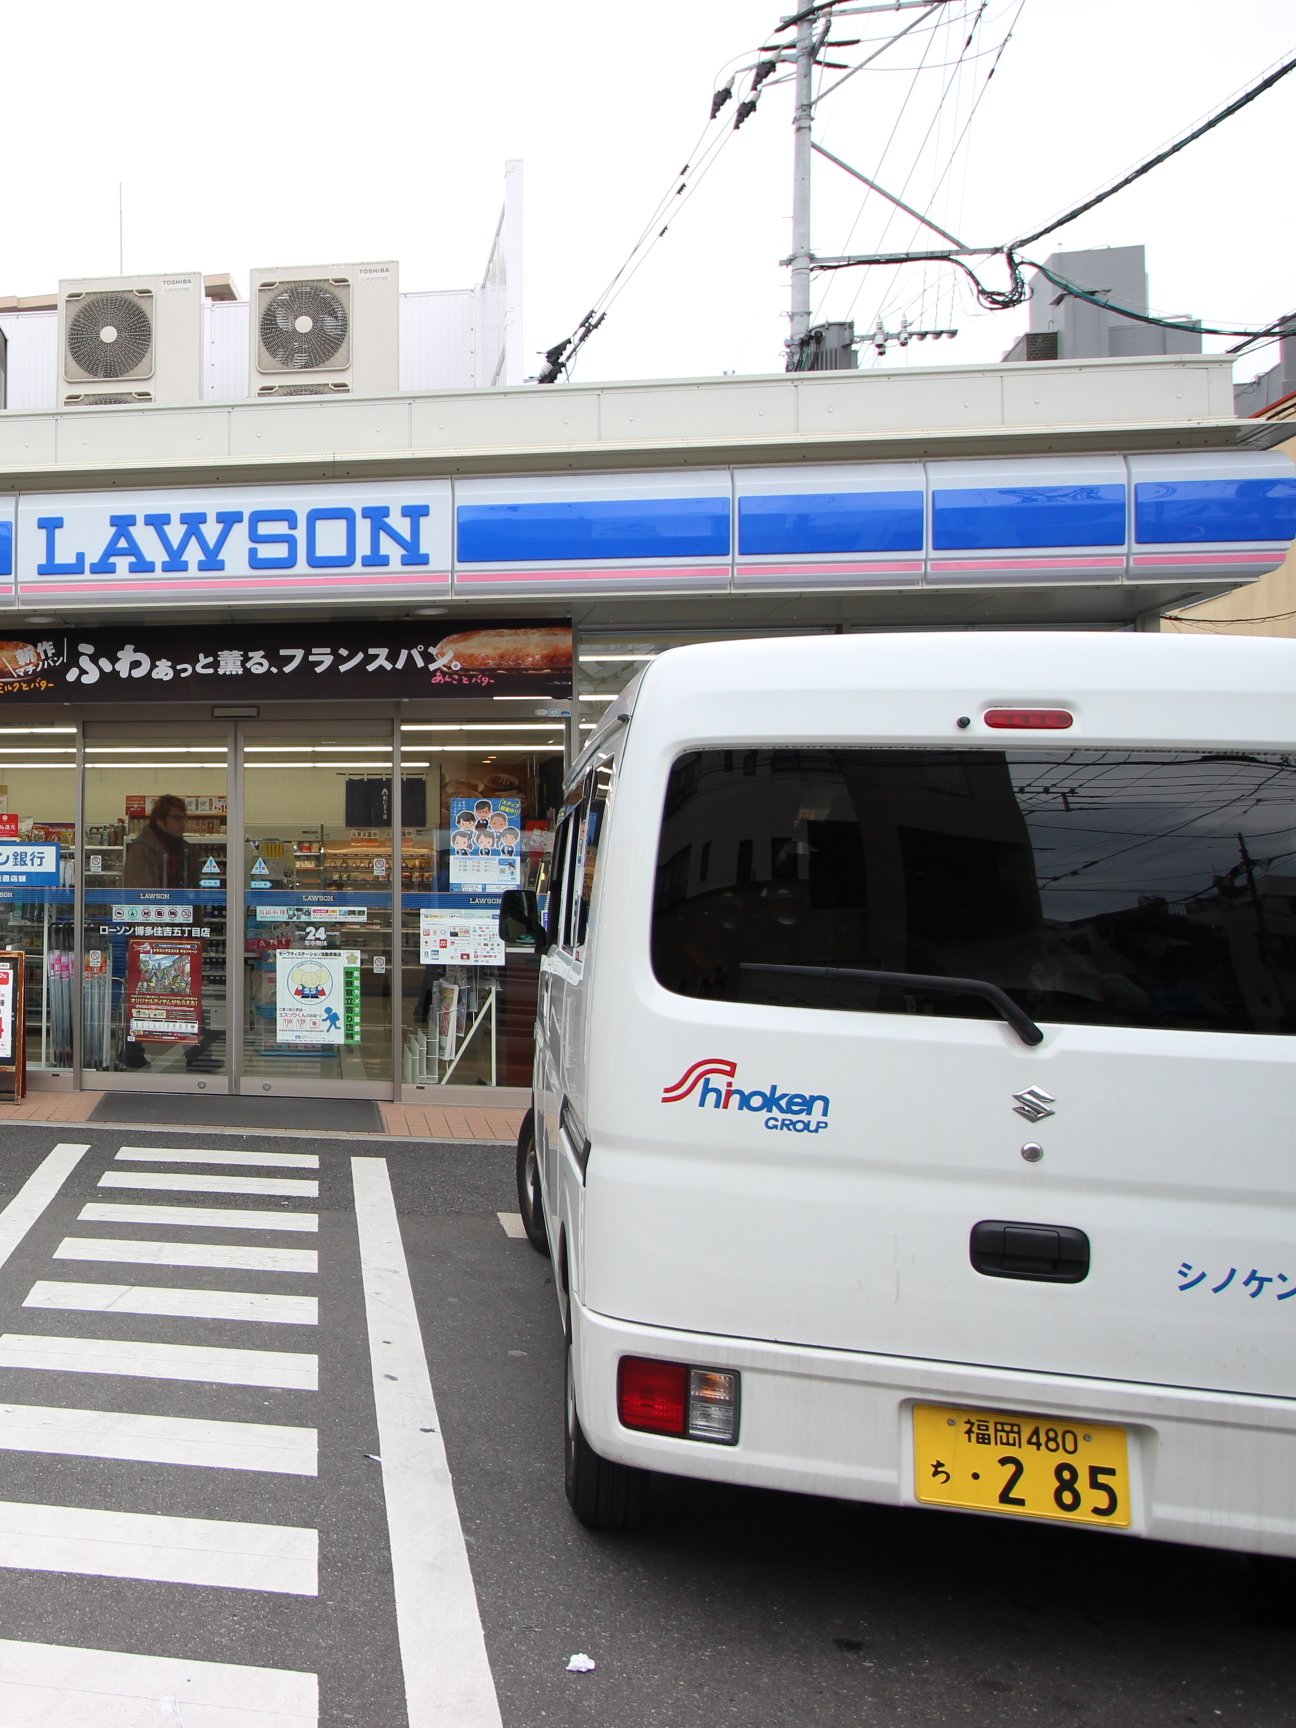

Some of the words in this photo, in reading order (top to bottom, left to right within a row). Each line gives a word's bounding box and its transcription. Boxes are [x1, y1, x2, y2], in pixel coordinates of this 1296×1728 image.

[37, 504, 430, 576] LAWSON
[14, 641, 55, 665] 新作
[431, 671, 495, 685] あんことバター
[99, 925, 211, 937] ローソン博多住吉五丁目店
[305, 926, 326, 940] 24
[661, 1058, 830, 1117] Shinoken
[764, 1116, 829, 1134] GROUP
[1177, 1262, 1296, 1301] シノケン
[930, 1460, 951, 1484] ち
